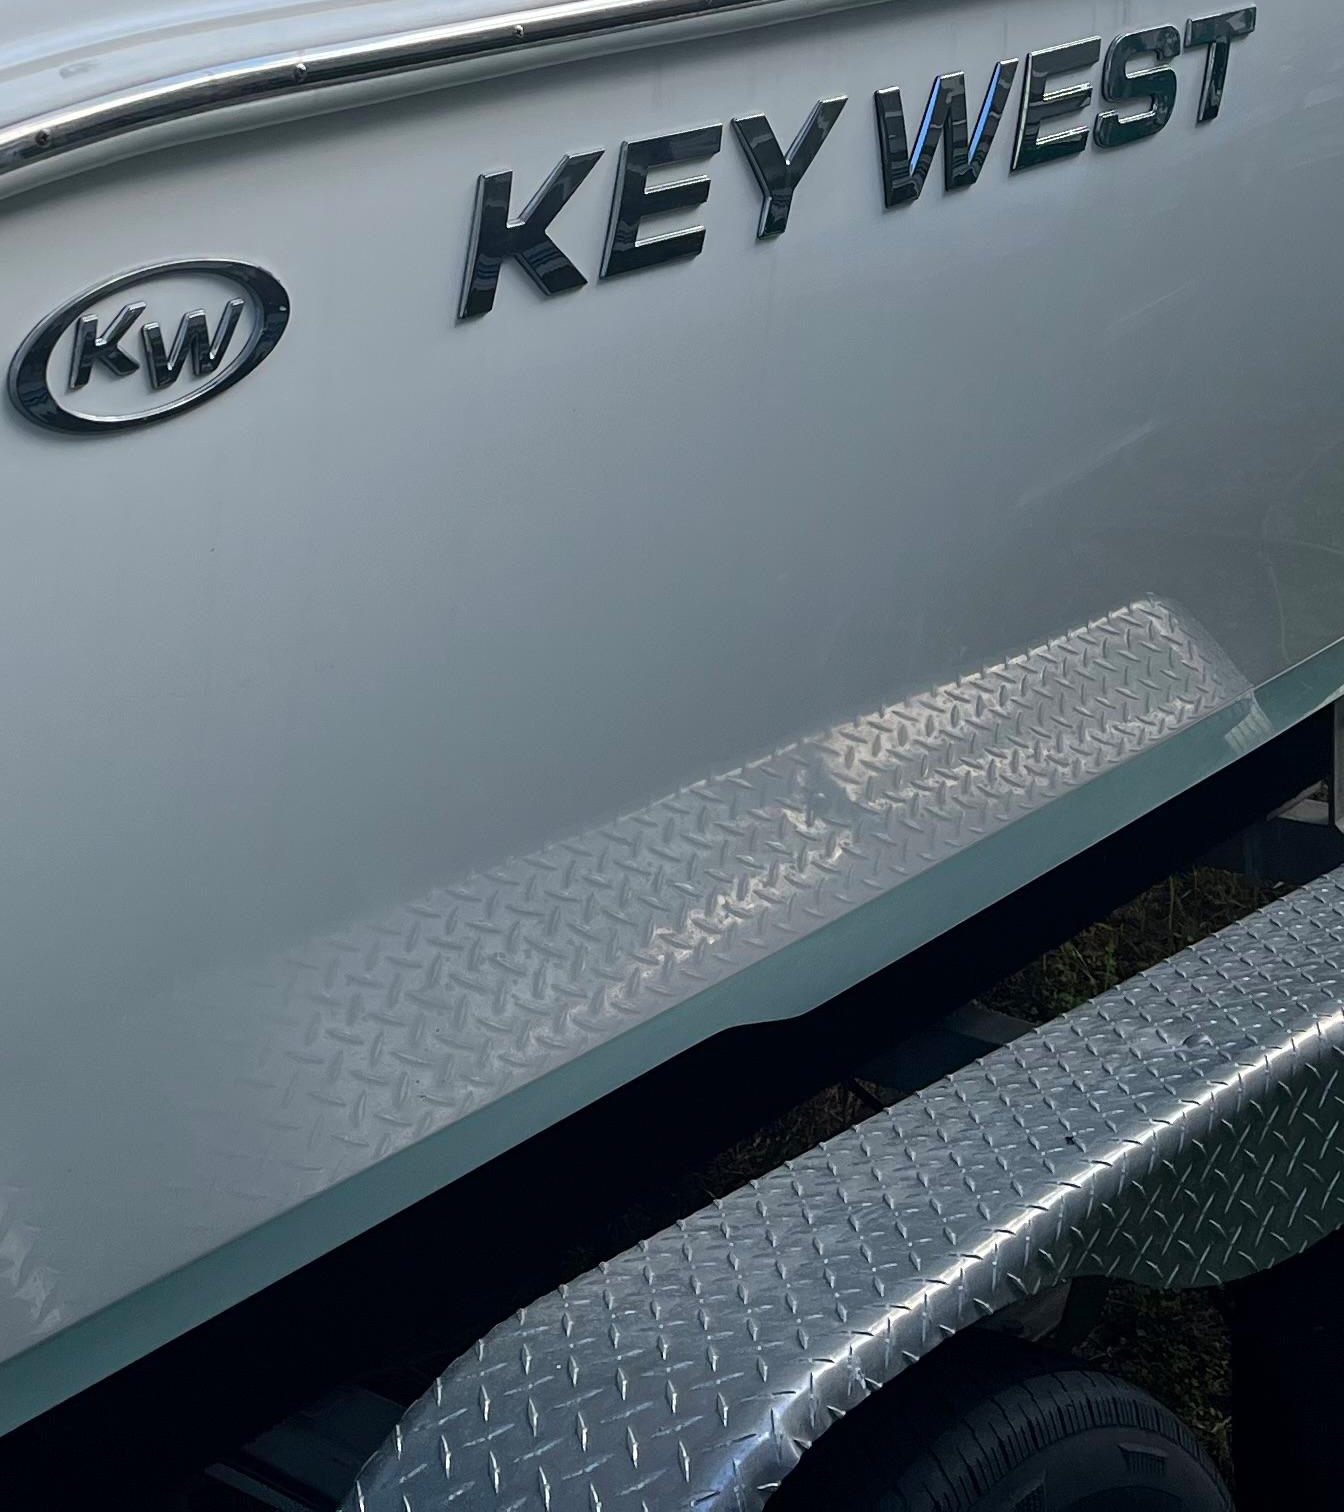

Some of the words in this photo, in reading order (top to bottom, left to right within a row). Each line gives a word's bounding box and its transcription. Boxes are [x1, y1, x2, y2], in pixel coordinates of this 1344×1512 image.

[457, 95, 849, 320] KEY
[874, 3, 1257, 208] WEST
[68, 298, 245, 390] KW
